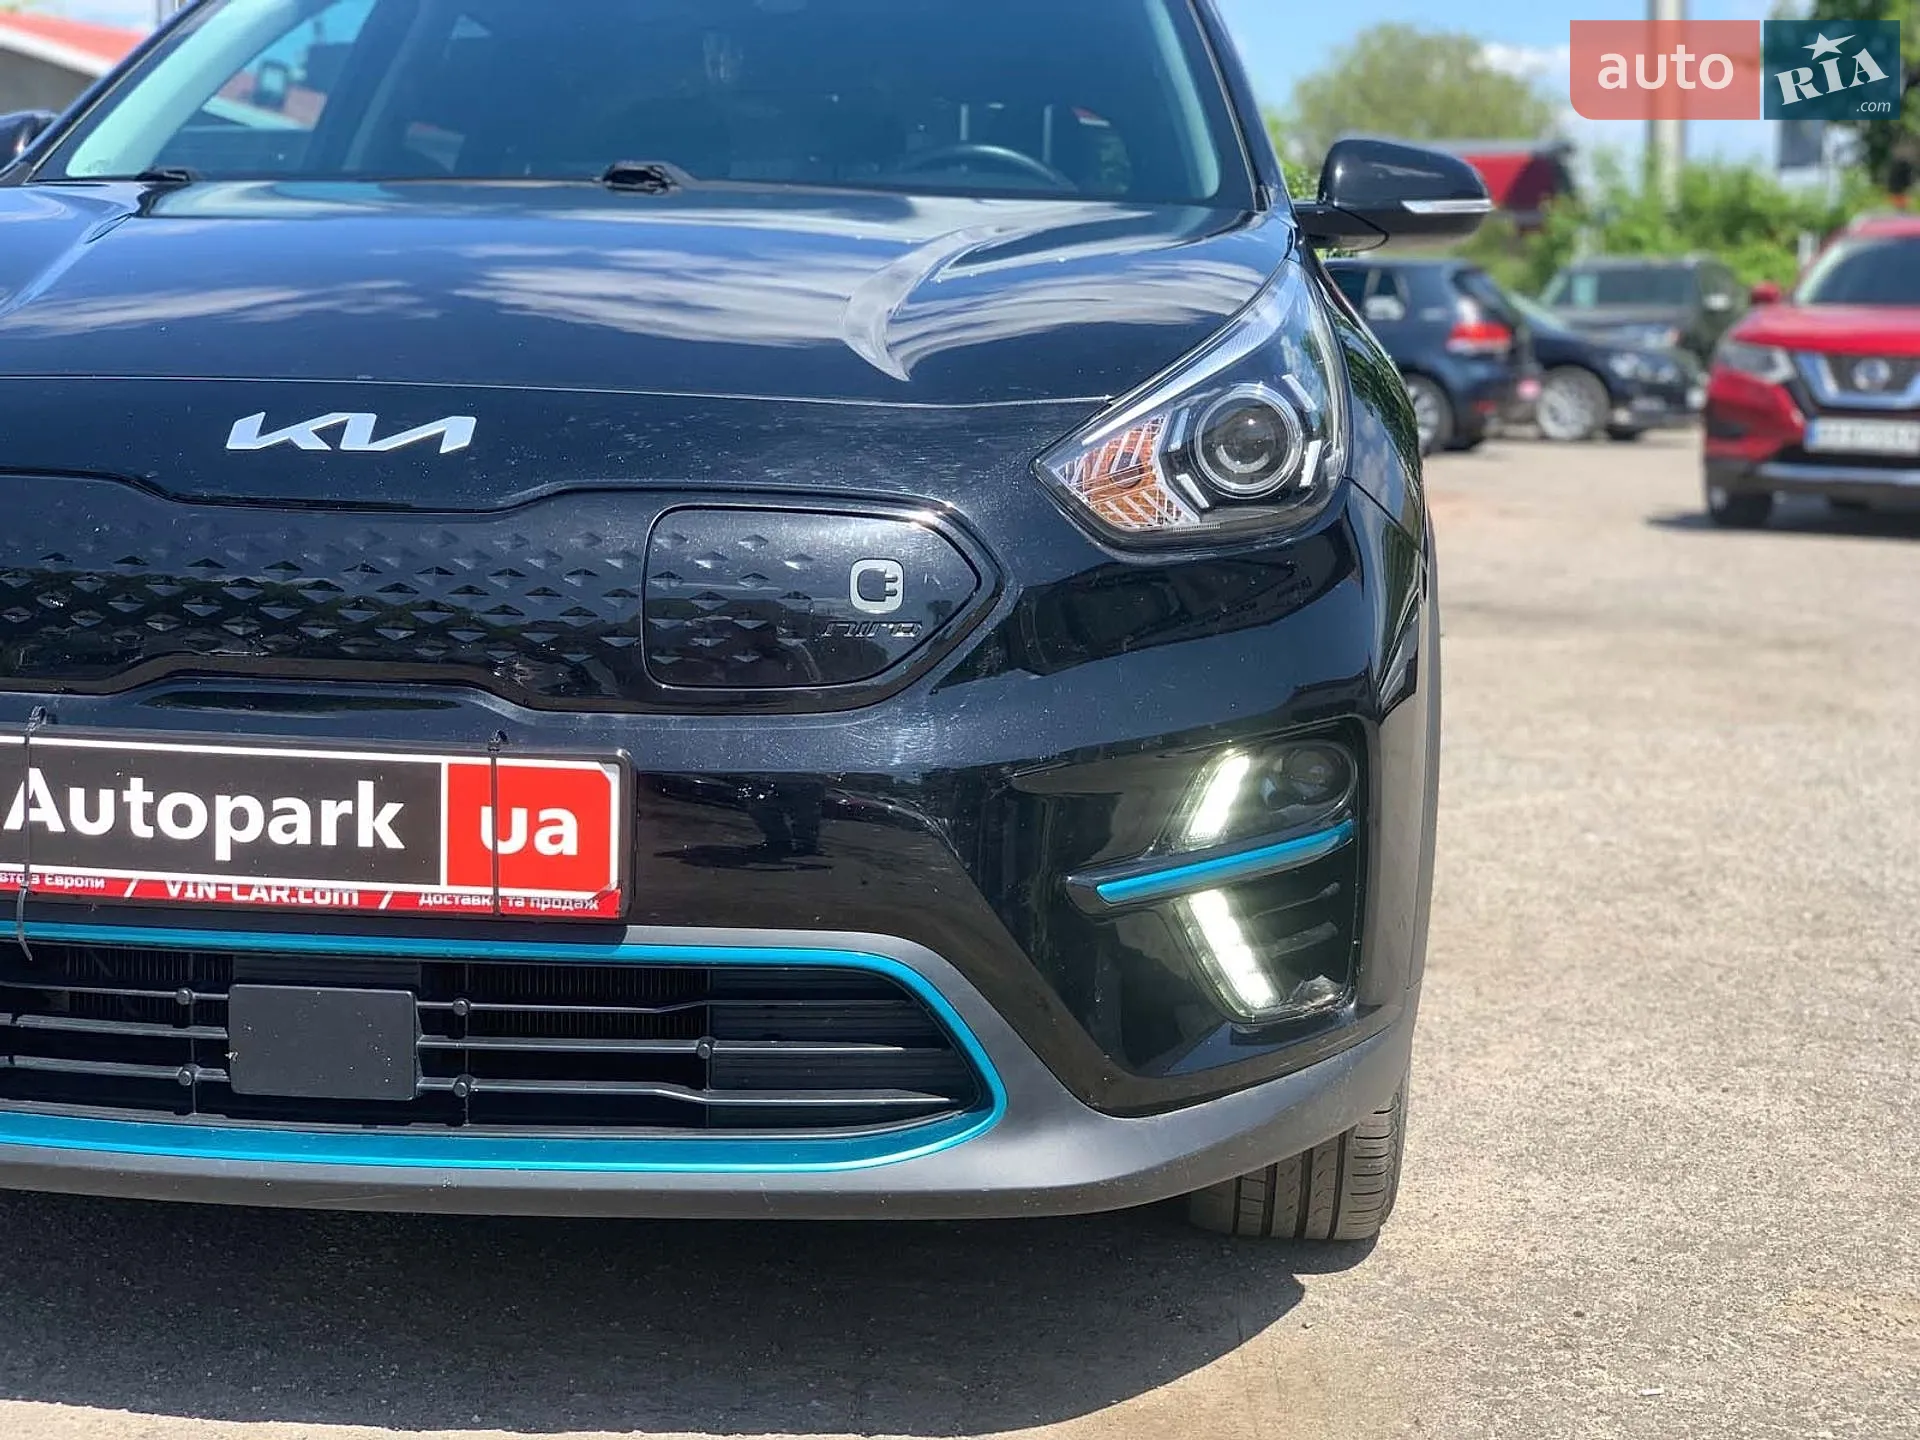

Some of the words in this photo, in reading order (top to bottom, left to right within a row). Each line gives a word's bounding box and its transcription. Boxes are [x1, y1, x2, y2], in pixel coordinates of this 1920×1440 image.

[226, 411, 476, 453] KIA
[3, 767, 405, 862] Autopark
[480, 805, 578, 856] ua
